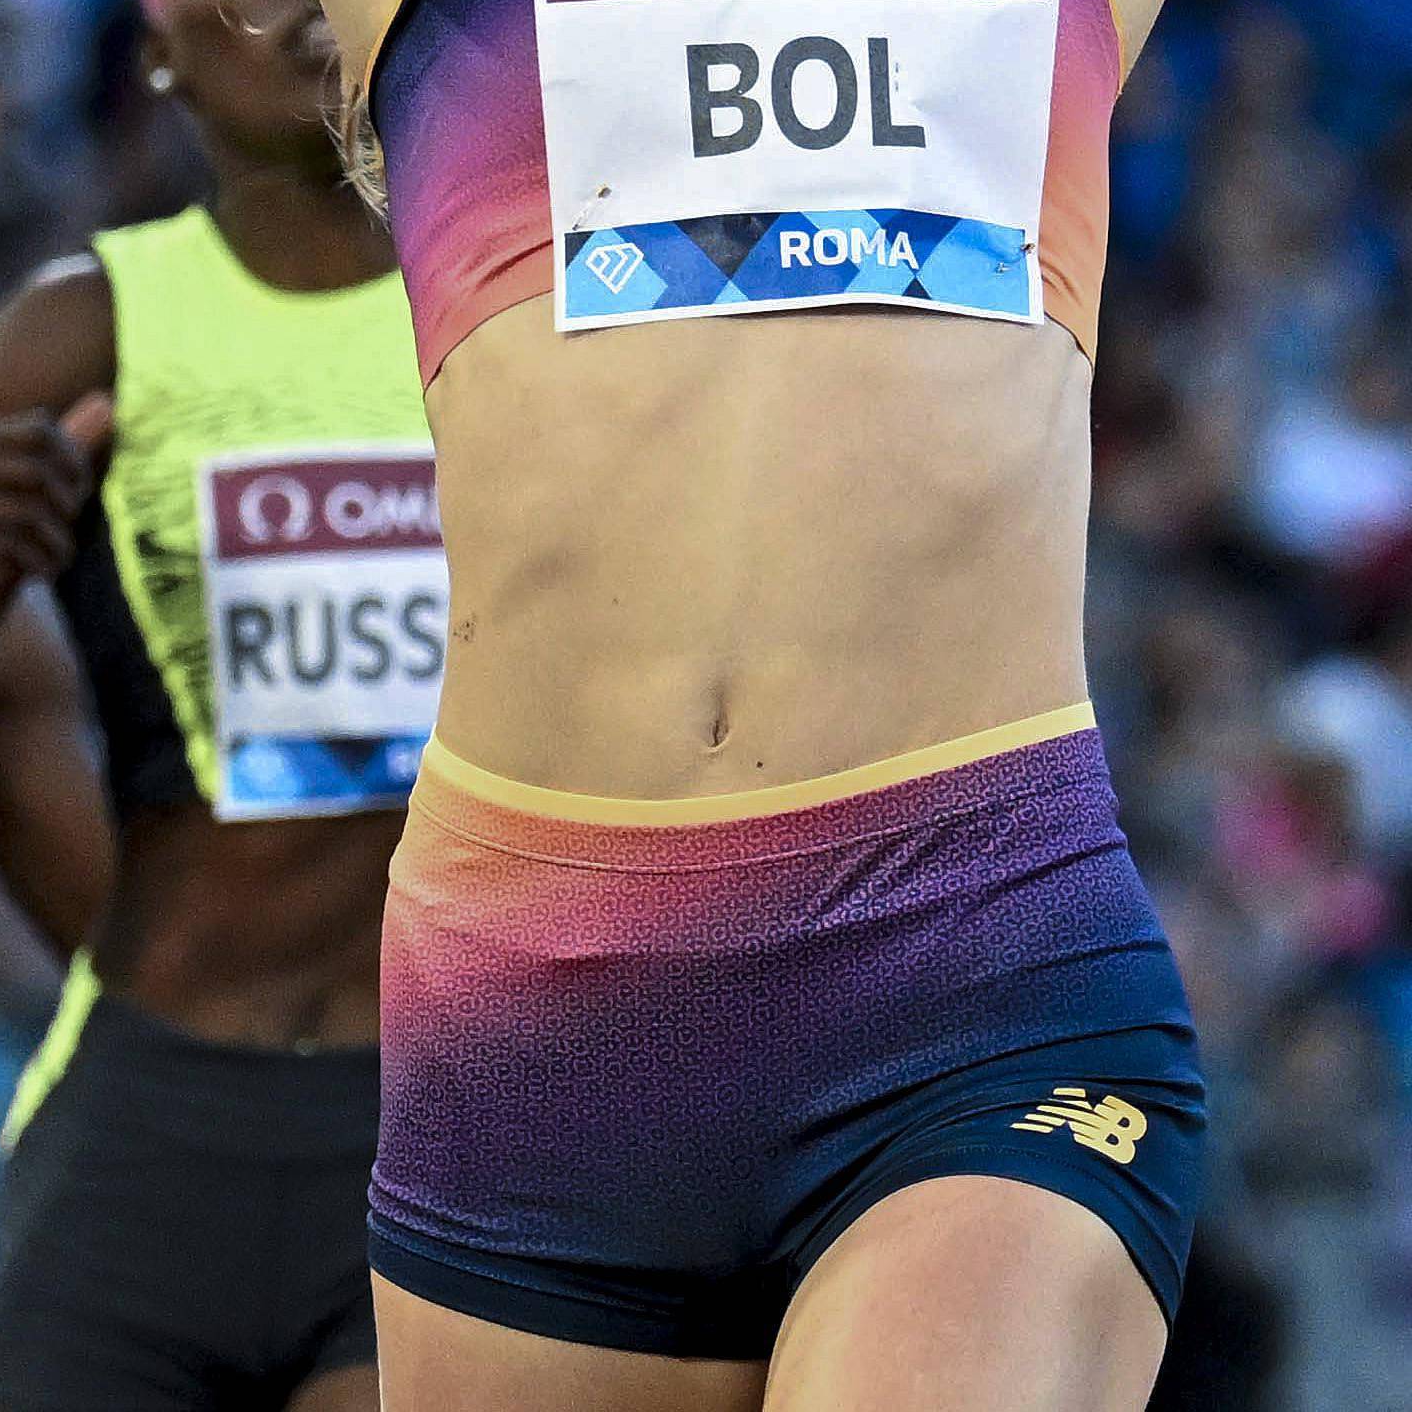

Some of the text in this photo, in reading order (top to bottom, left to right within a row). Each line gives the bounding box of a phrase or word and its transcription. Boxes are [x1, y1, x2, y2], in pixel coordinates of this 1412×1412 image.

[686, 36, 927, 158] BOL
[779, 227, 919, 270] ROMA
[324, 480, 441, 538] OM
[225, 591, 445, 688] RUSS
